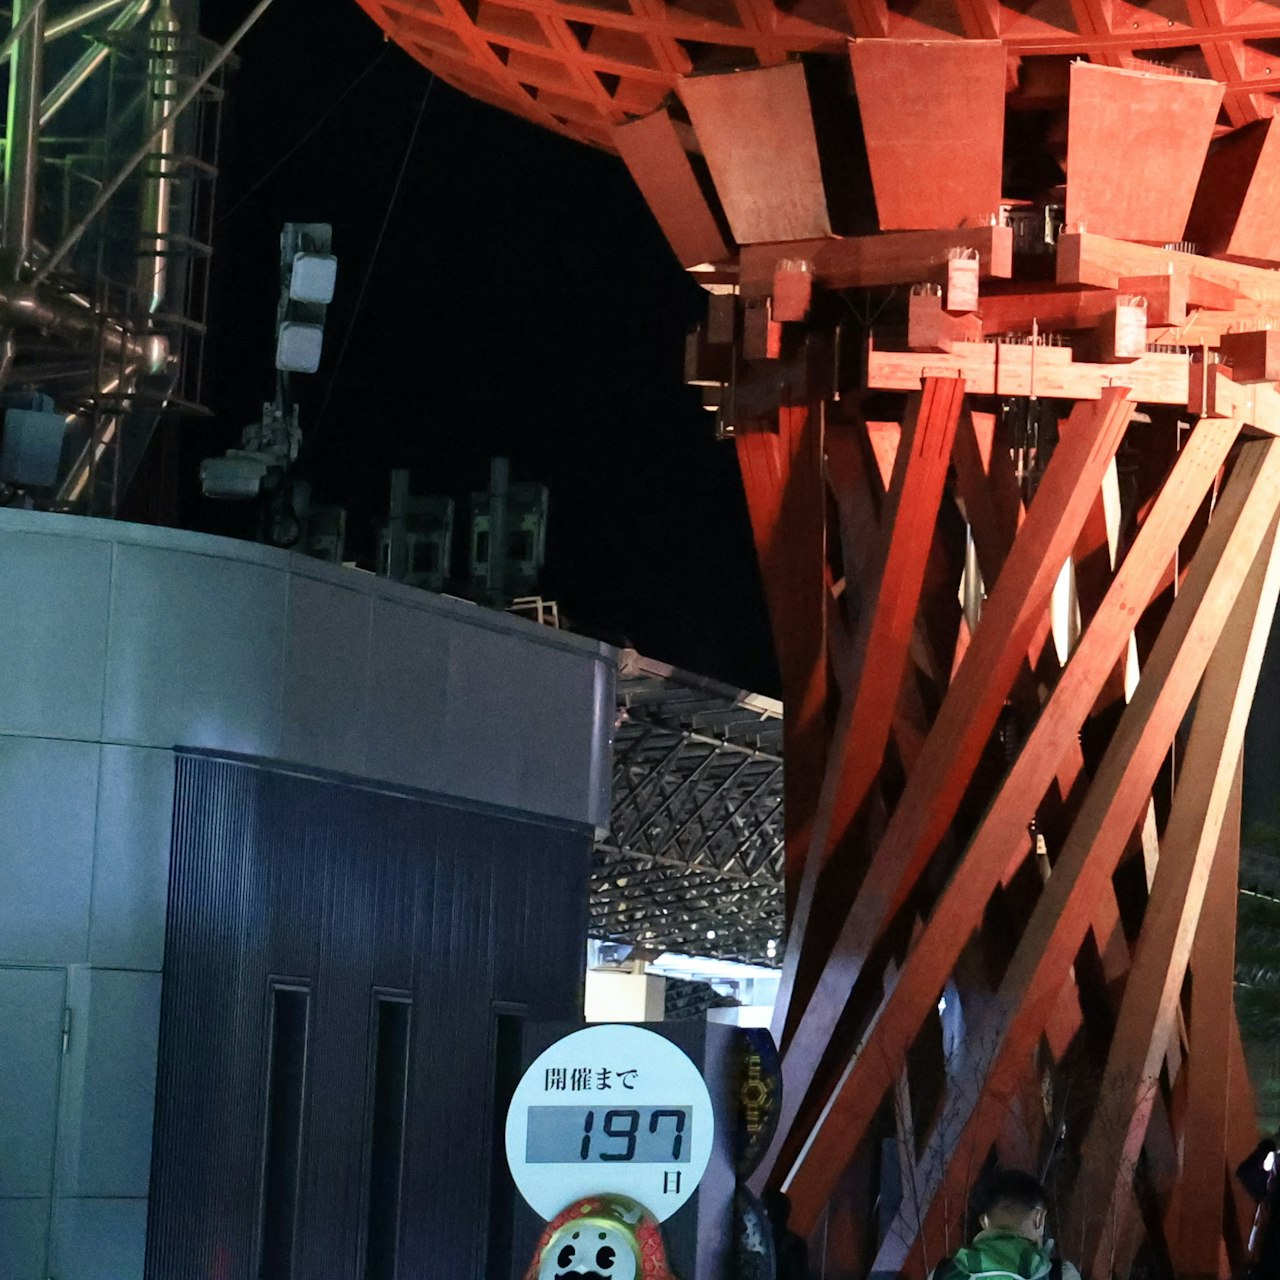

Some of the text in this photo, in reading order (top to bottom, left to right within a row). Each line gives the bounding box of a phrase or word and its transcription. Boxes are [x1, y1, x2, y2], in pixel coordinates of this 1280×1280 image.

[544, 1066, 639, 1092] 開催まで
[579, 1109, 687, 1162] 197
[662, 1170, 682, 1195] 日
